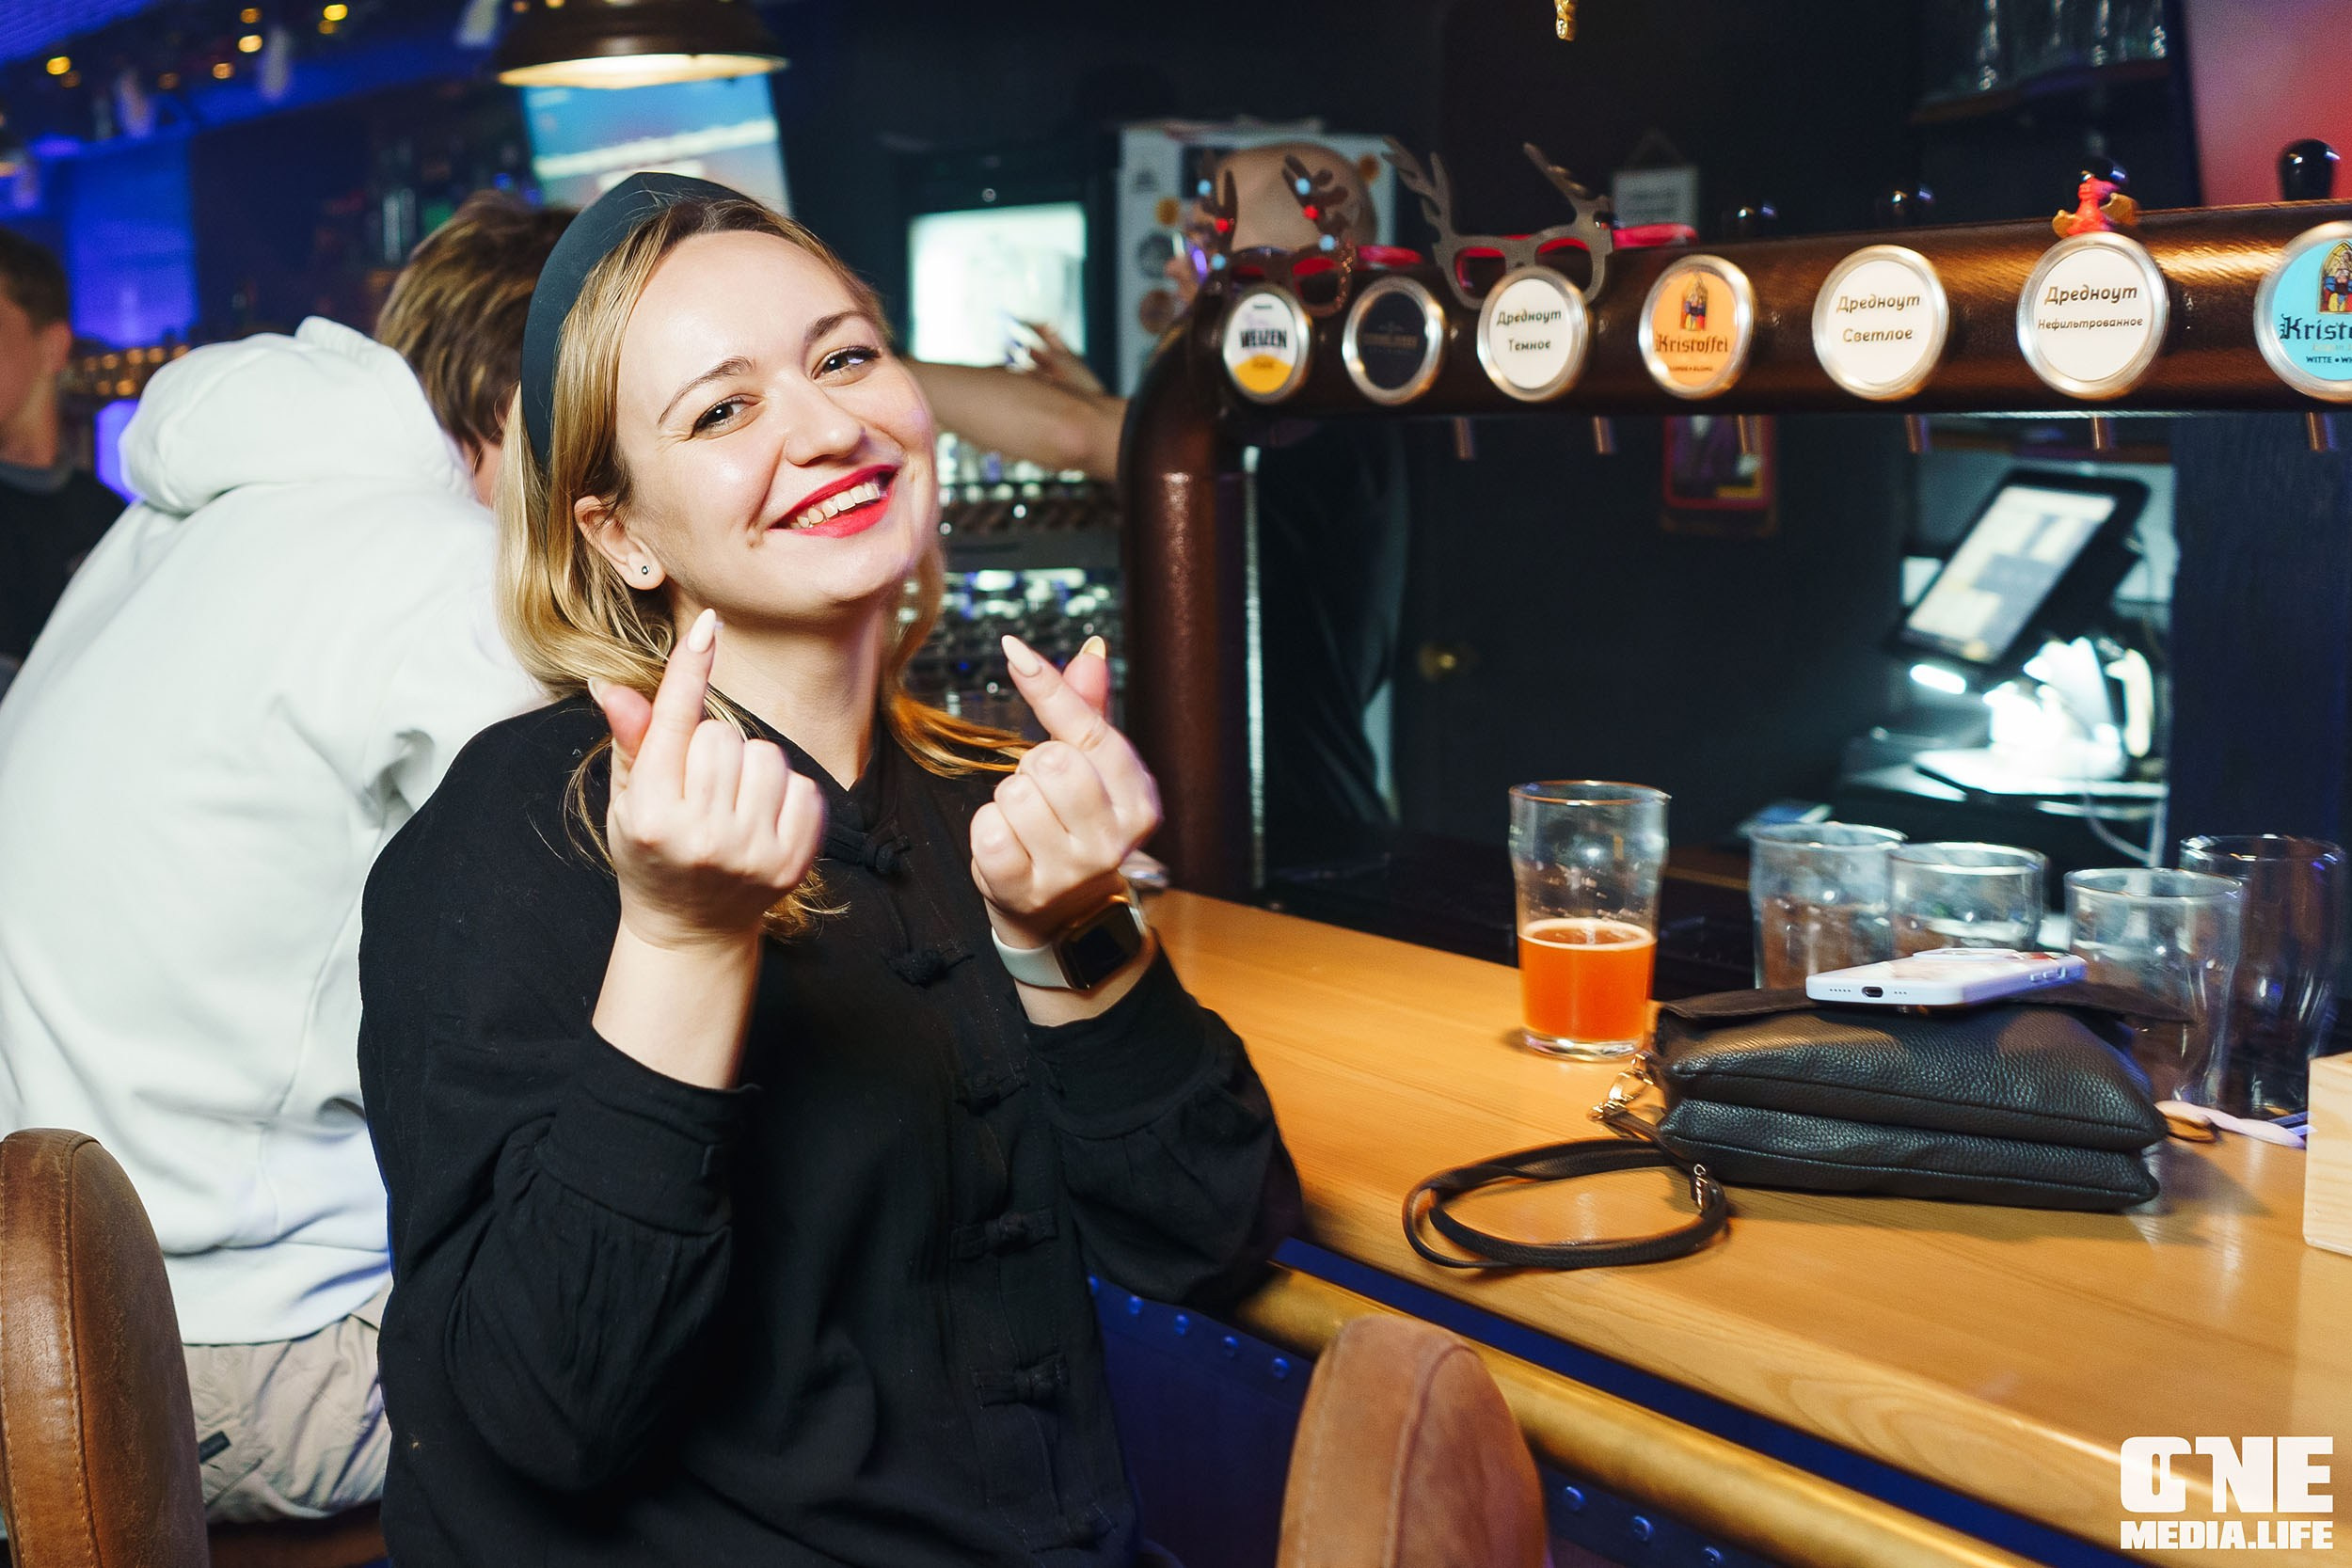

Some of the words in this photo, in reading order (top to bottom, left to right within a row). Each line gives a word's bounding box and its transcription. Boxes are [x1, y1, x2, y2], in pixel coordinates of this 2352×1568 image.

[1836, 293, 1920, 313] Дредноут
[2044, 284, 2138, 306] Дредноут
[1497, 309, 1562, 325] Дредноут
[2038, 318, 2144, 331] Нефильтрованное
[1240, 329, 1287, 348] WEIZEN
[1655, 331, 1728, 354] Kristoffel
[1843, 327, 1913, 342] Светлое
[1509, 340, 1550, 352] Темное
